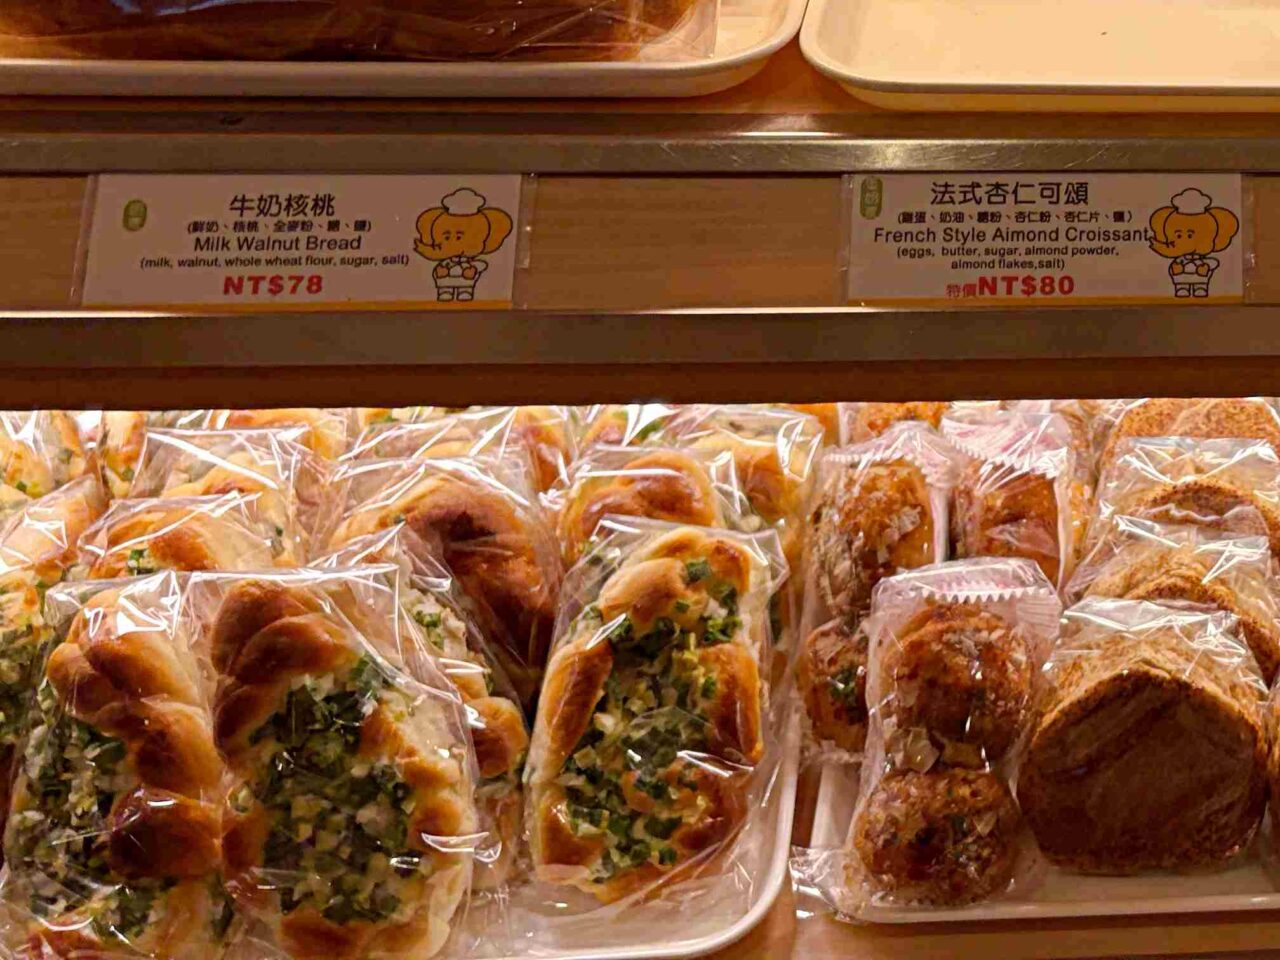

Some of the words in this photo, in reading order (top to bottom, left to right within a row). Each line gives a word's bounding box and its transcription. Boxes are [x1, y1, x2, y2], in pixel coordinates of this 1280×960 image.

[930, 182, 1089, 205] 法式杏仁可頌
[229, 194, 335, 218] 牛奶核桃
[195, 236, 230, 251] Milk
[237, 236, 300, 251] Walnut
[305, 235, 362, 250] Bread
[874, 228, 936, 243] French
[943, 227, 986, 244] Style
[992, 227, 1059, 242] Almond
[1064, 227, 1149, 242] Croissant
[1024, 246, 1069, 256] almond
[140, 257, 173, 269] (milk,
[177, 256, 221, 269] walnut,
[225, 256, 262, 267] whole
[265, 256, 302, 267] wheat
[305, 255, 337, 267] flour,
[339, 256, 379, 268] sugar,
[382, 255, 409, 267] salt)
[951, 259, 995, 270] almond
[223, 275, 324, 296] NT$78
